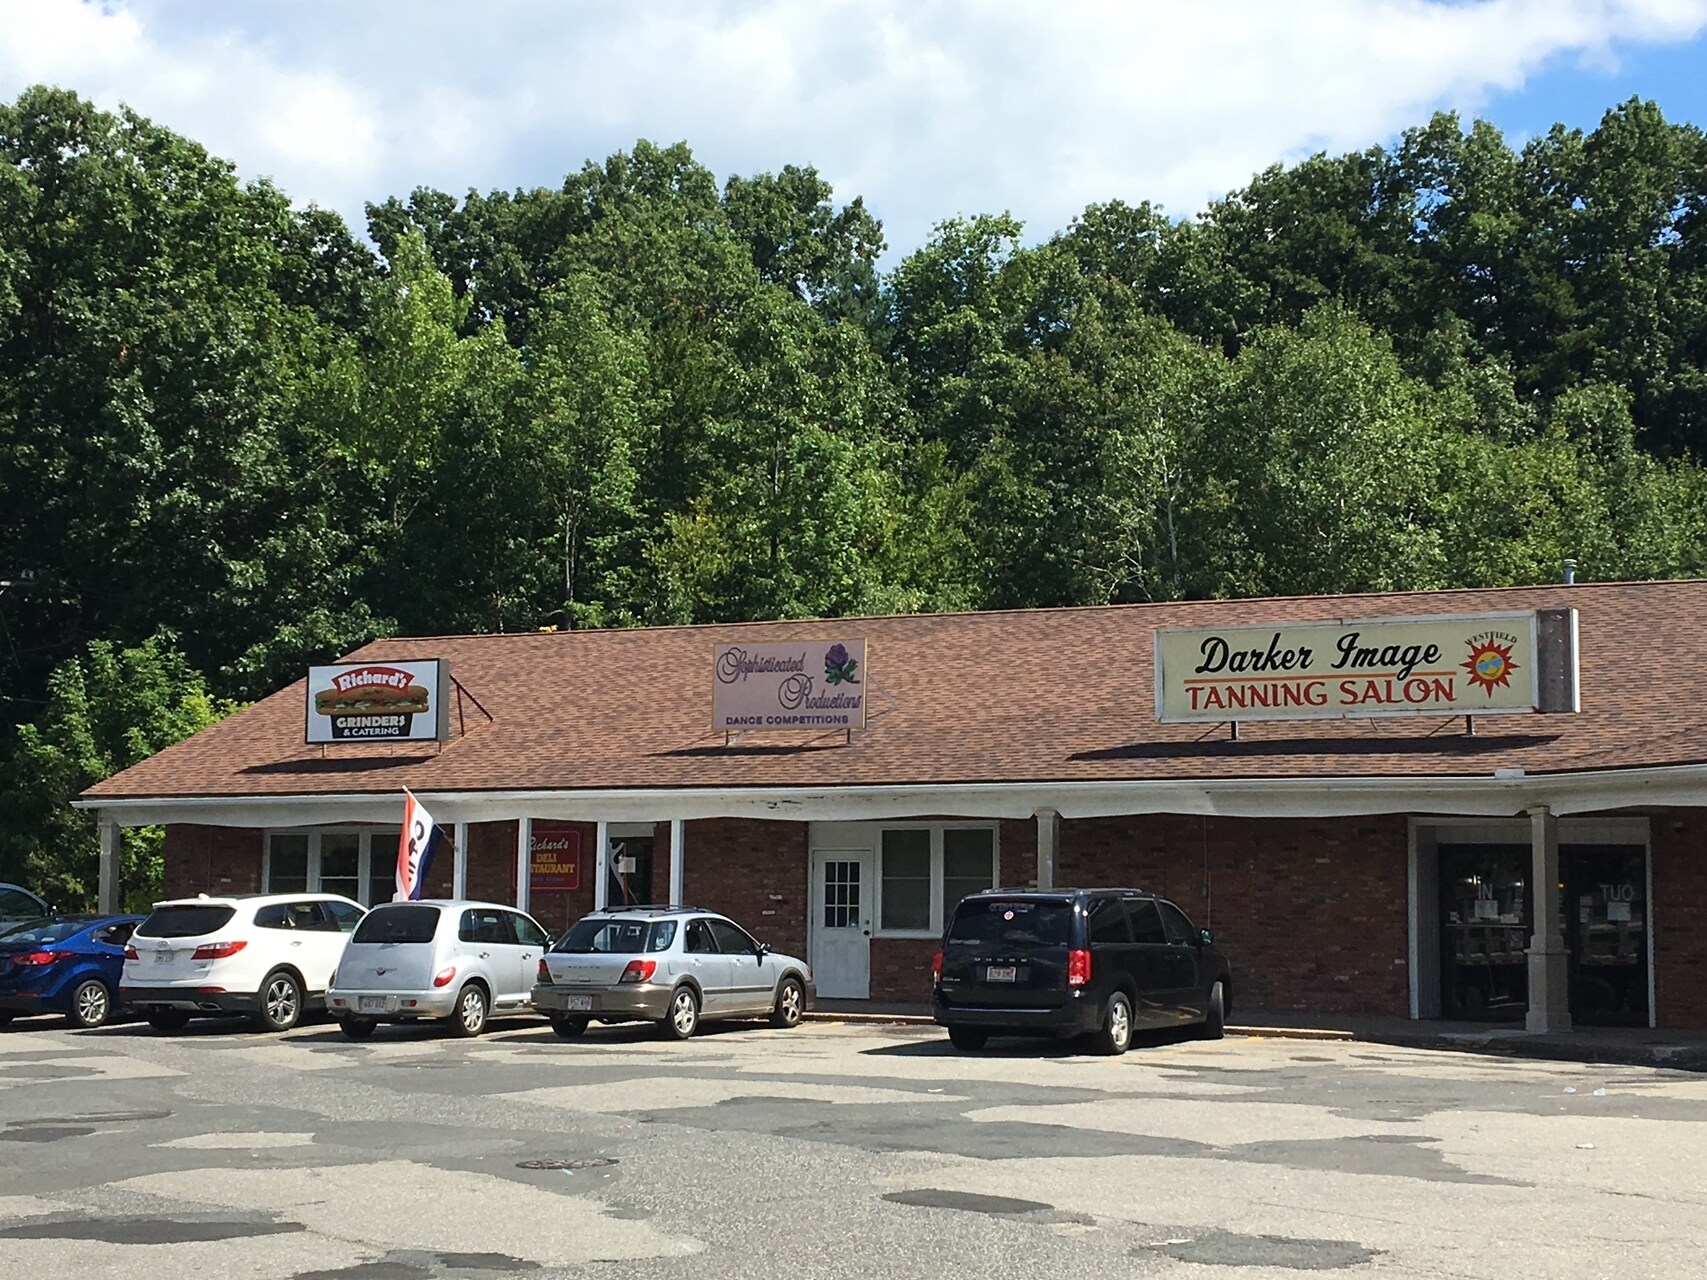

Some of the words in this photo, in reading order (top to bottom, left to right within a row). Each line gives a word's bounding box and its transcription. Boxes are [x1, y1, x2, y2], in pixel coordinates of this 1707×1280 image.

[1464, 631, 1518, 646] WESTFIELD
[1195, 632, 1314, 674] Darker
[1330, 632, 1442, 681] Image
[716, 647, 806, 684] Sophisticated
[338, 670, 407, 691] Richard's
[778, 673, 862, 710] Productions
[1185, 681, 1328, 710] TANNING
[1339, 678, 1457, 705] SALON
[336, 715, 406, 728] GRINDERS
[726, 715, 763, 725] DANCE
[767, 715, 849, 725] COMPETITIONS
[352, 727, 399, 736] CATERING
[536, 853, 557, 863] DELI
[1478, 883, 1493, 900] IN
